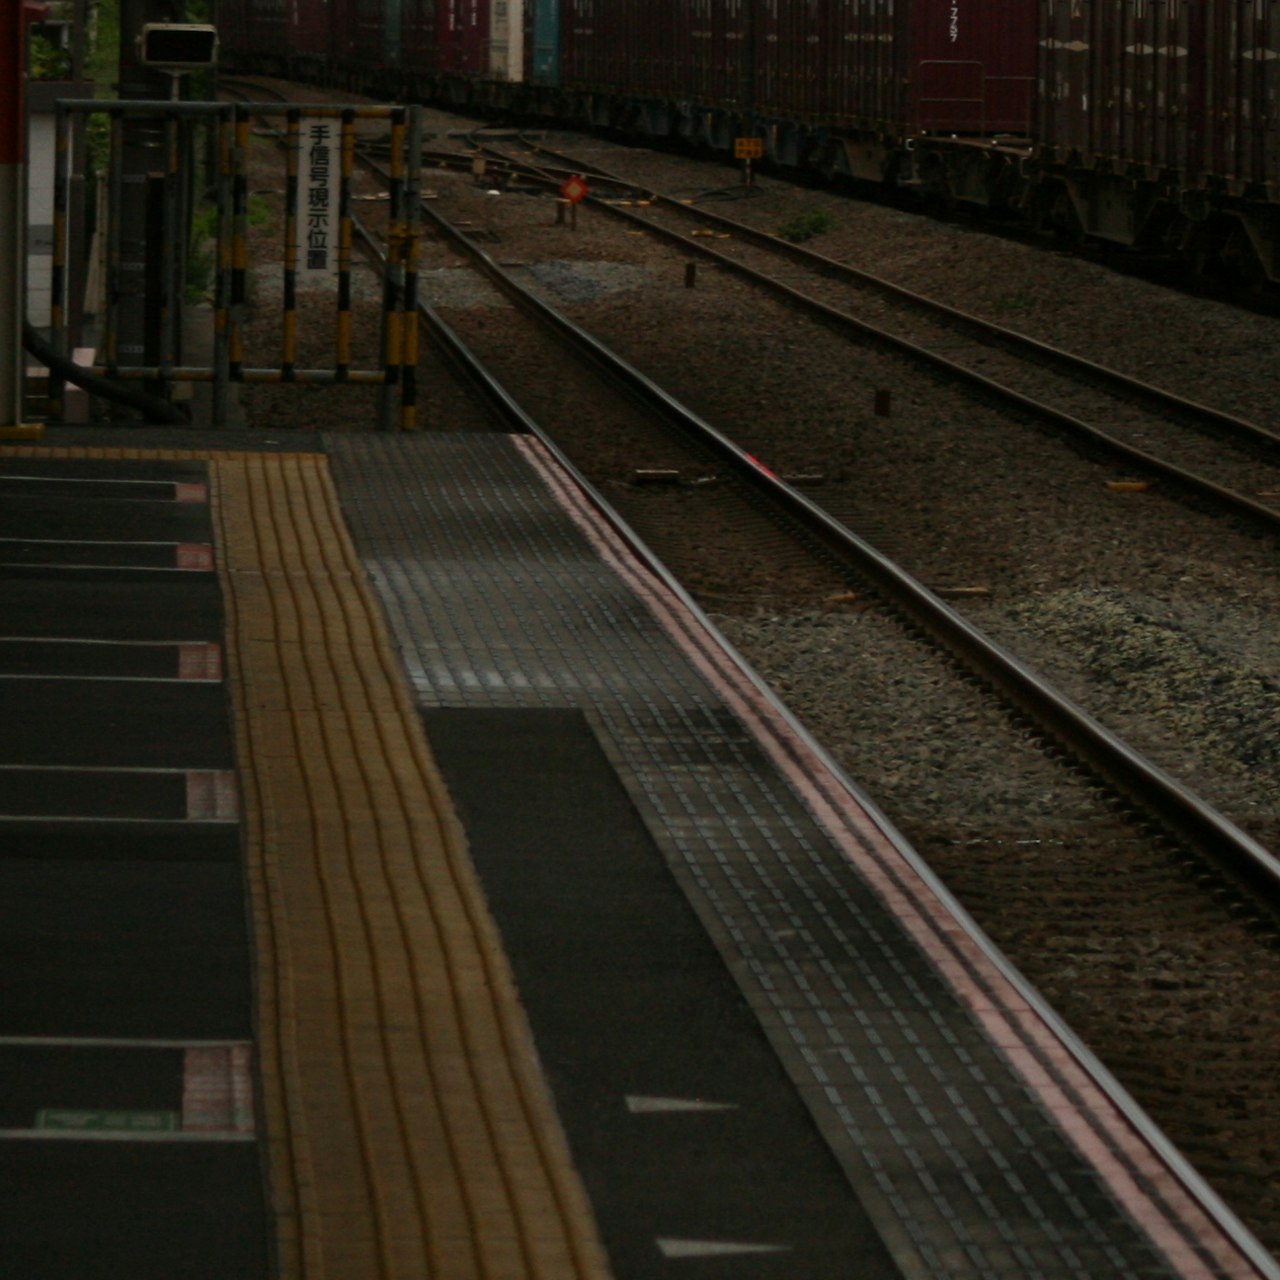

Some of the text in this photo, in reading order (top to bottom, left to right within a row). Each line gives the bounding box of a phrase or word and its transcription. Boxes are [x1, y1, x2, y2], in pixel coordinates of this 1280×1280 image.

[308, 125, 330, 269] 手信号現示位置
